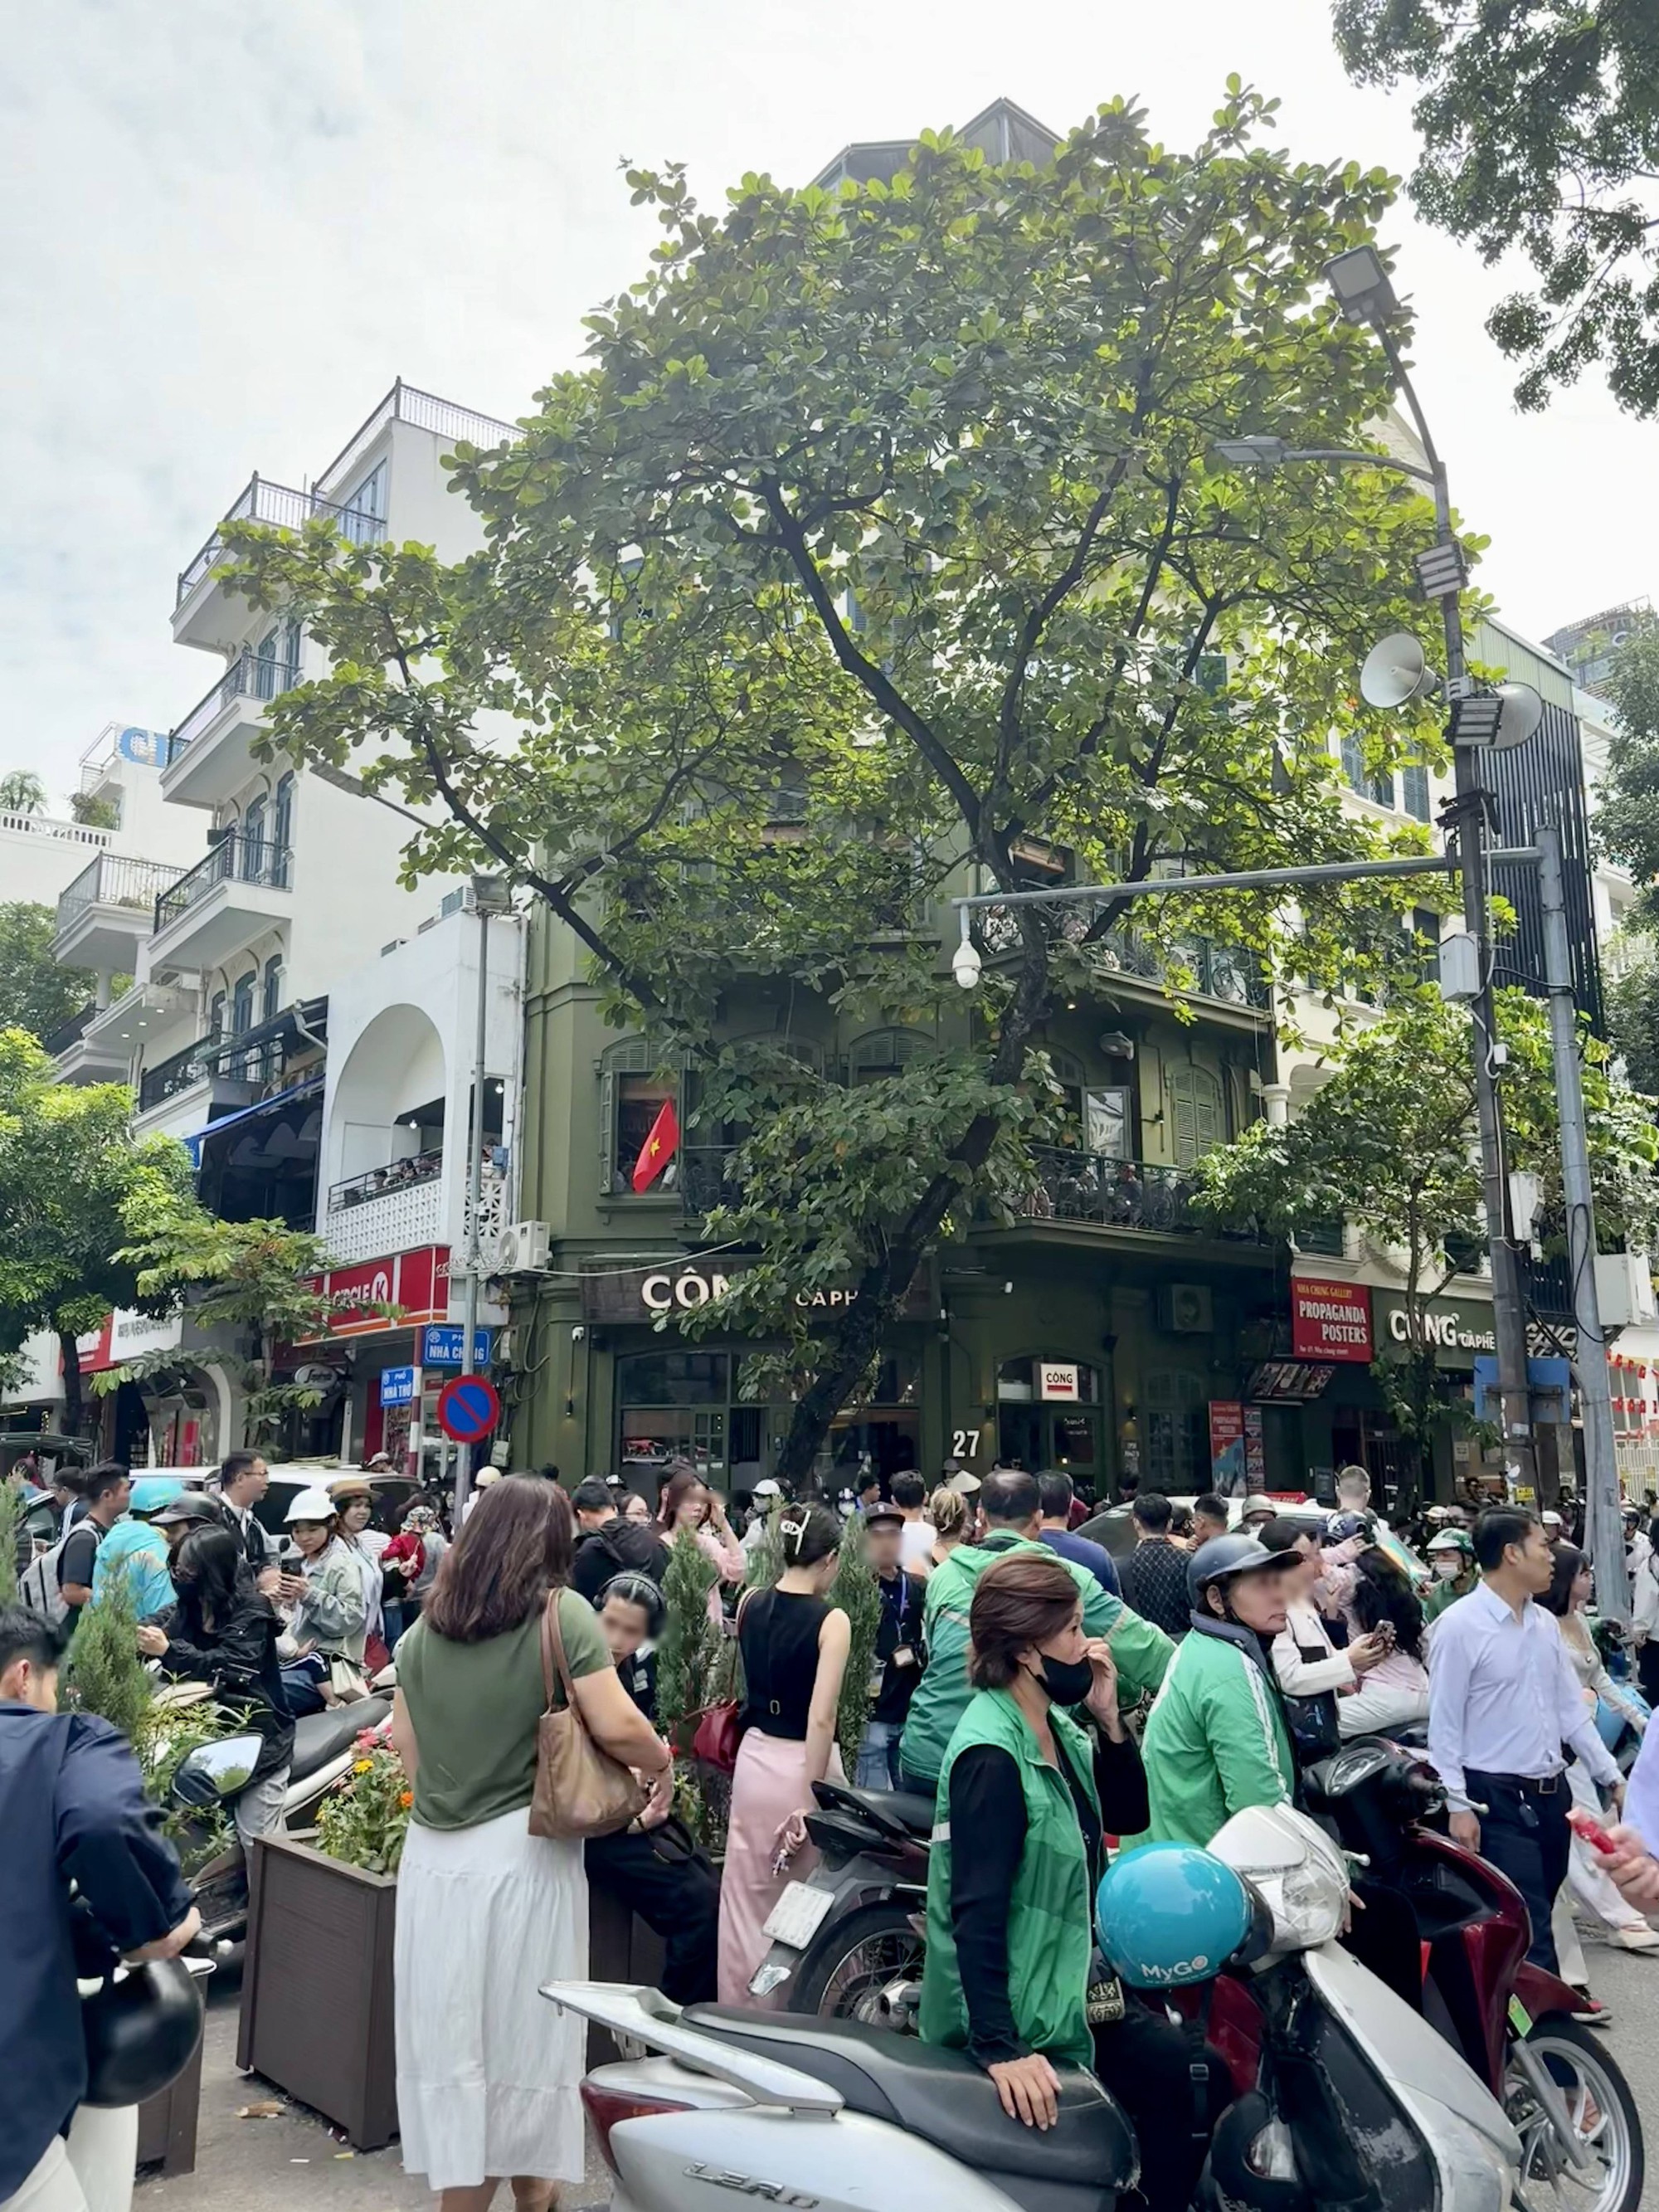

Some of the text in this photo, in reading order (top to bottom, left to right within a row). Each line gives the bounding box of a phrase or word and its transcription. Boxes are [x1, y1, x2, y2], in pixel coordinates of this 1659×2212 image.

[1299, 1300, 1367, 1324] PROPAGANDA
[1321, 1323, 1368, 1344] POSTERS
[452, 1346, 485, 1361] CHG
[952, 1430, 980, 1458] 27
[1141, 1955, 1209, 1981] MyGO
